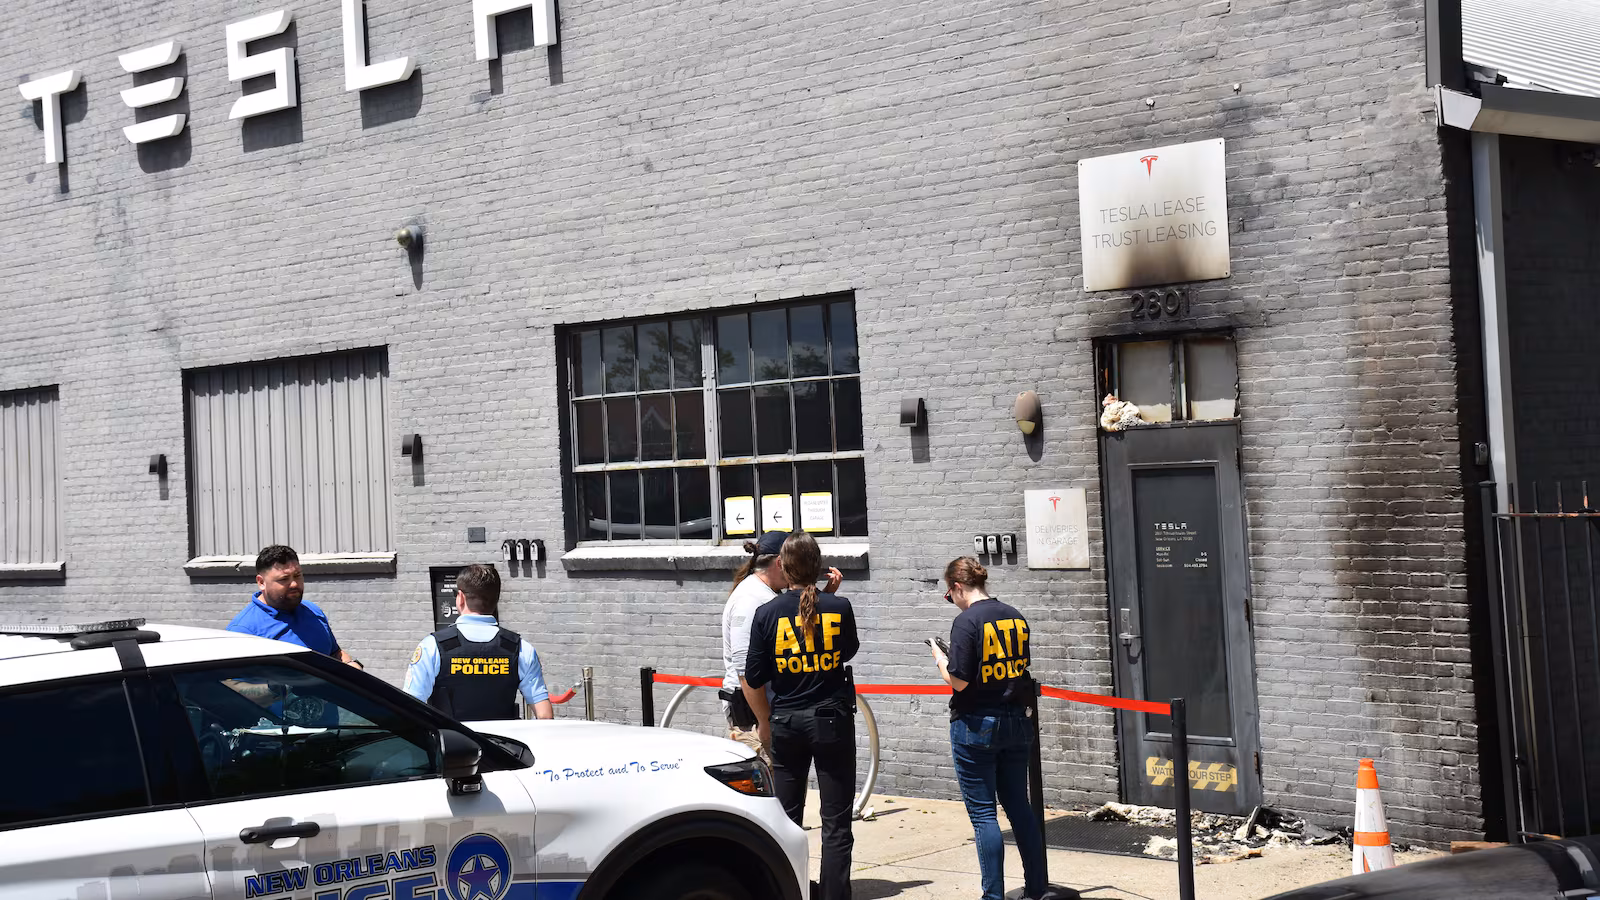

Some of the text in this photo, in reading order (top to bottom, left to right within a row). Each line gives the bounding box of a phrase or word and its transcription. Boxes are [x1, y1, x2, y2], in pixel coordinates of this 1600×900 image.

[1099, 196, 1206, 224] TESLA LEASE
[1091, 220, 1217, 249] TRUST LEASING
[1129, 284, 1190, 320] 2801
[1034, 524, 1079, 534] DELIVERIES
[1154, 522, 1187, 530] TESLA
[1046, 536, 1078, 546] GARAGE
[774, 612, 842, 656] ATF
[982, 618, 1029, 663] ATF
[450, 664, 510, 675] POLICE
[775, 651, 841, 674] POLICE
[562, 767, 605, 781] Protect
[608, 763, 629, 776] and
[629, 761, 646, 773] To
[1152, 766, 1232, 782] WATC OUR STEP
[245, 866, 309, 899] NEW
[314, 845, 437, 885] ORLEANS
